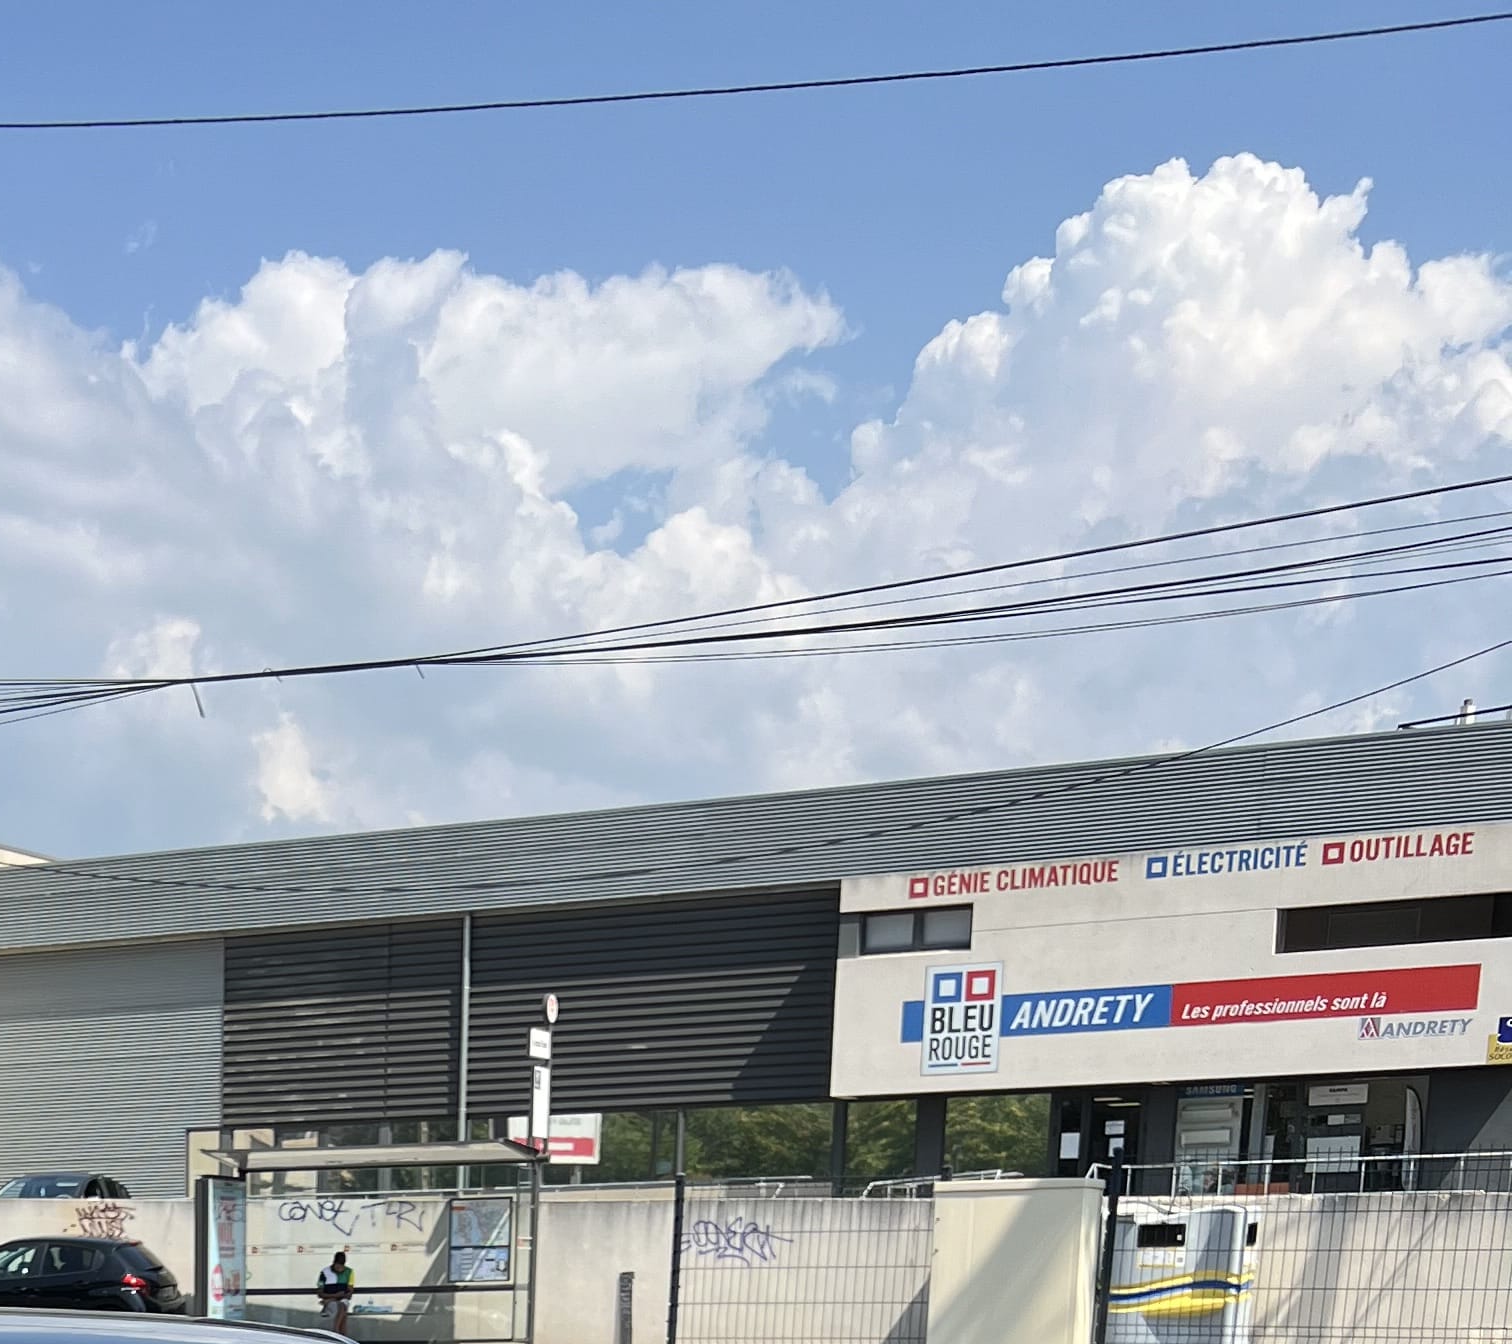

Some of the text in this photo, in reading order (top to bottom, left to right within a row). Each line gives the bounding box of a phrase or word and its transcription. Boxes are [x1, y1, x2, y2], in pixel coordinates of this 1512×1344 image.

[1172, 840, 1308, 877] ÉLECTRICITÉ
[1349, 832, 1475, 862] OUTILLAGE
[933, 860, 1120, 897] GÉNIE CLIMATIQUE
[930, 1004, 994, 1034] BLEU
[1009, 993, 1155, 1030] ANDRETY
[1181, 991, 1387, 1021] Les professionnels sont là
[1381, 1017, 1474, 1038] ANDRETY
[928, 1035, 992, 1061] ROUGE
[1185, 1084, 1237, 1096] SAMSUNG
